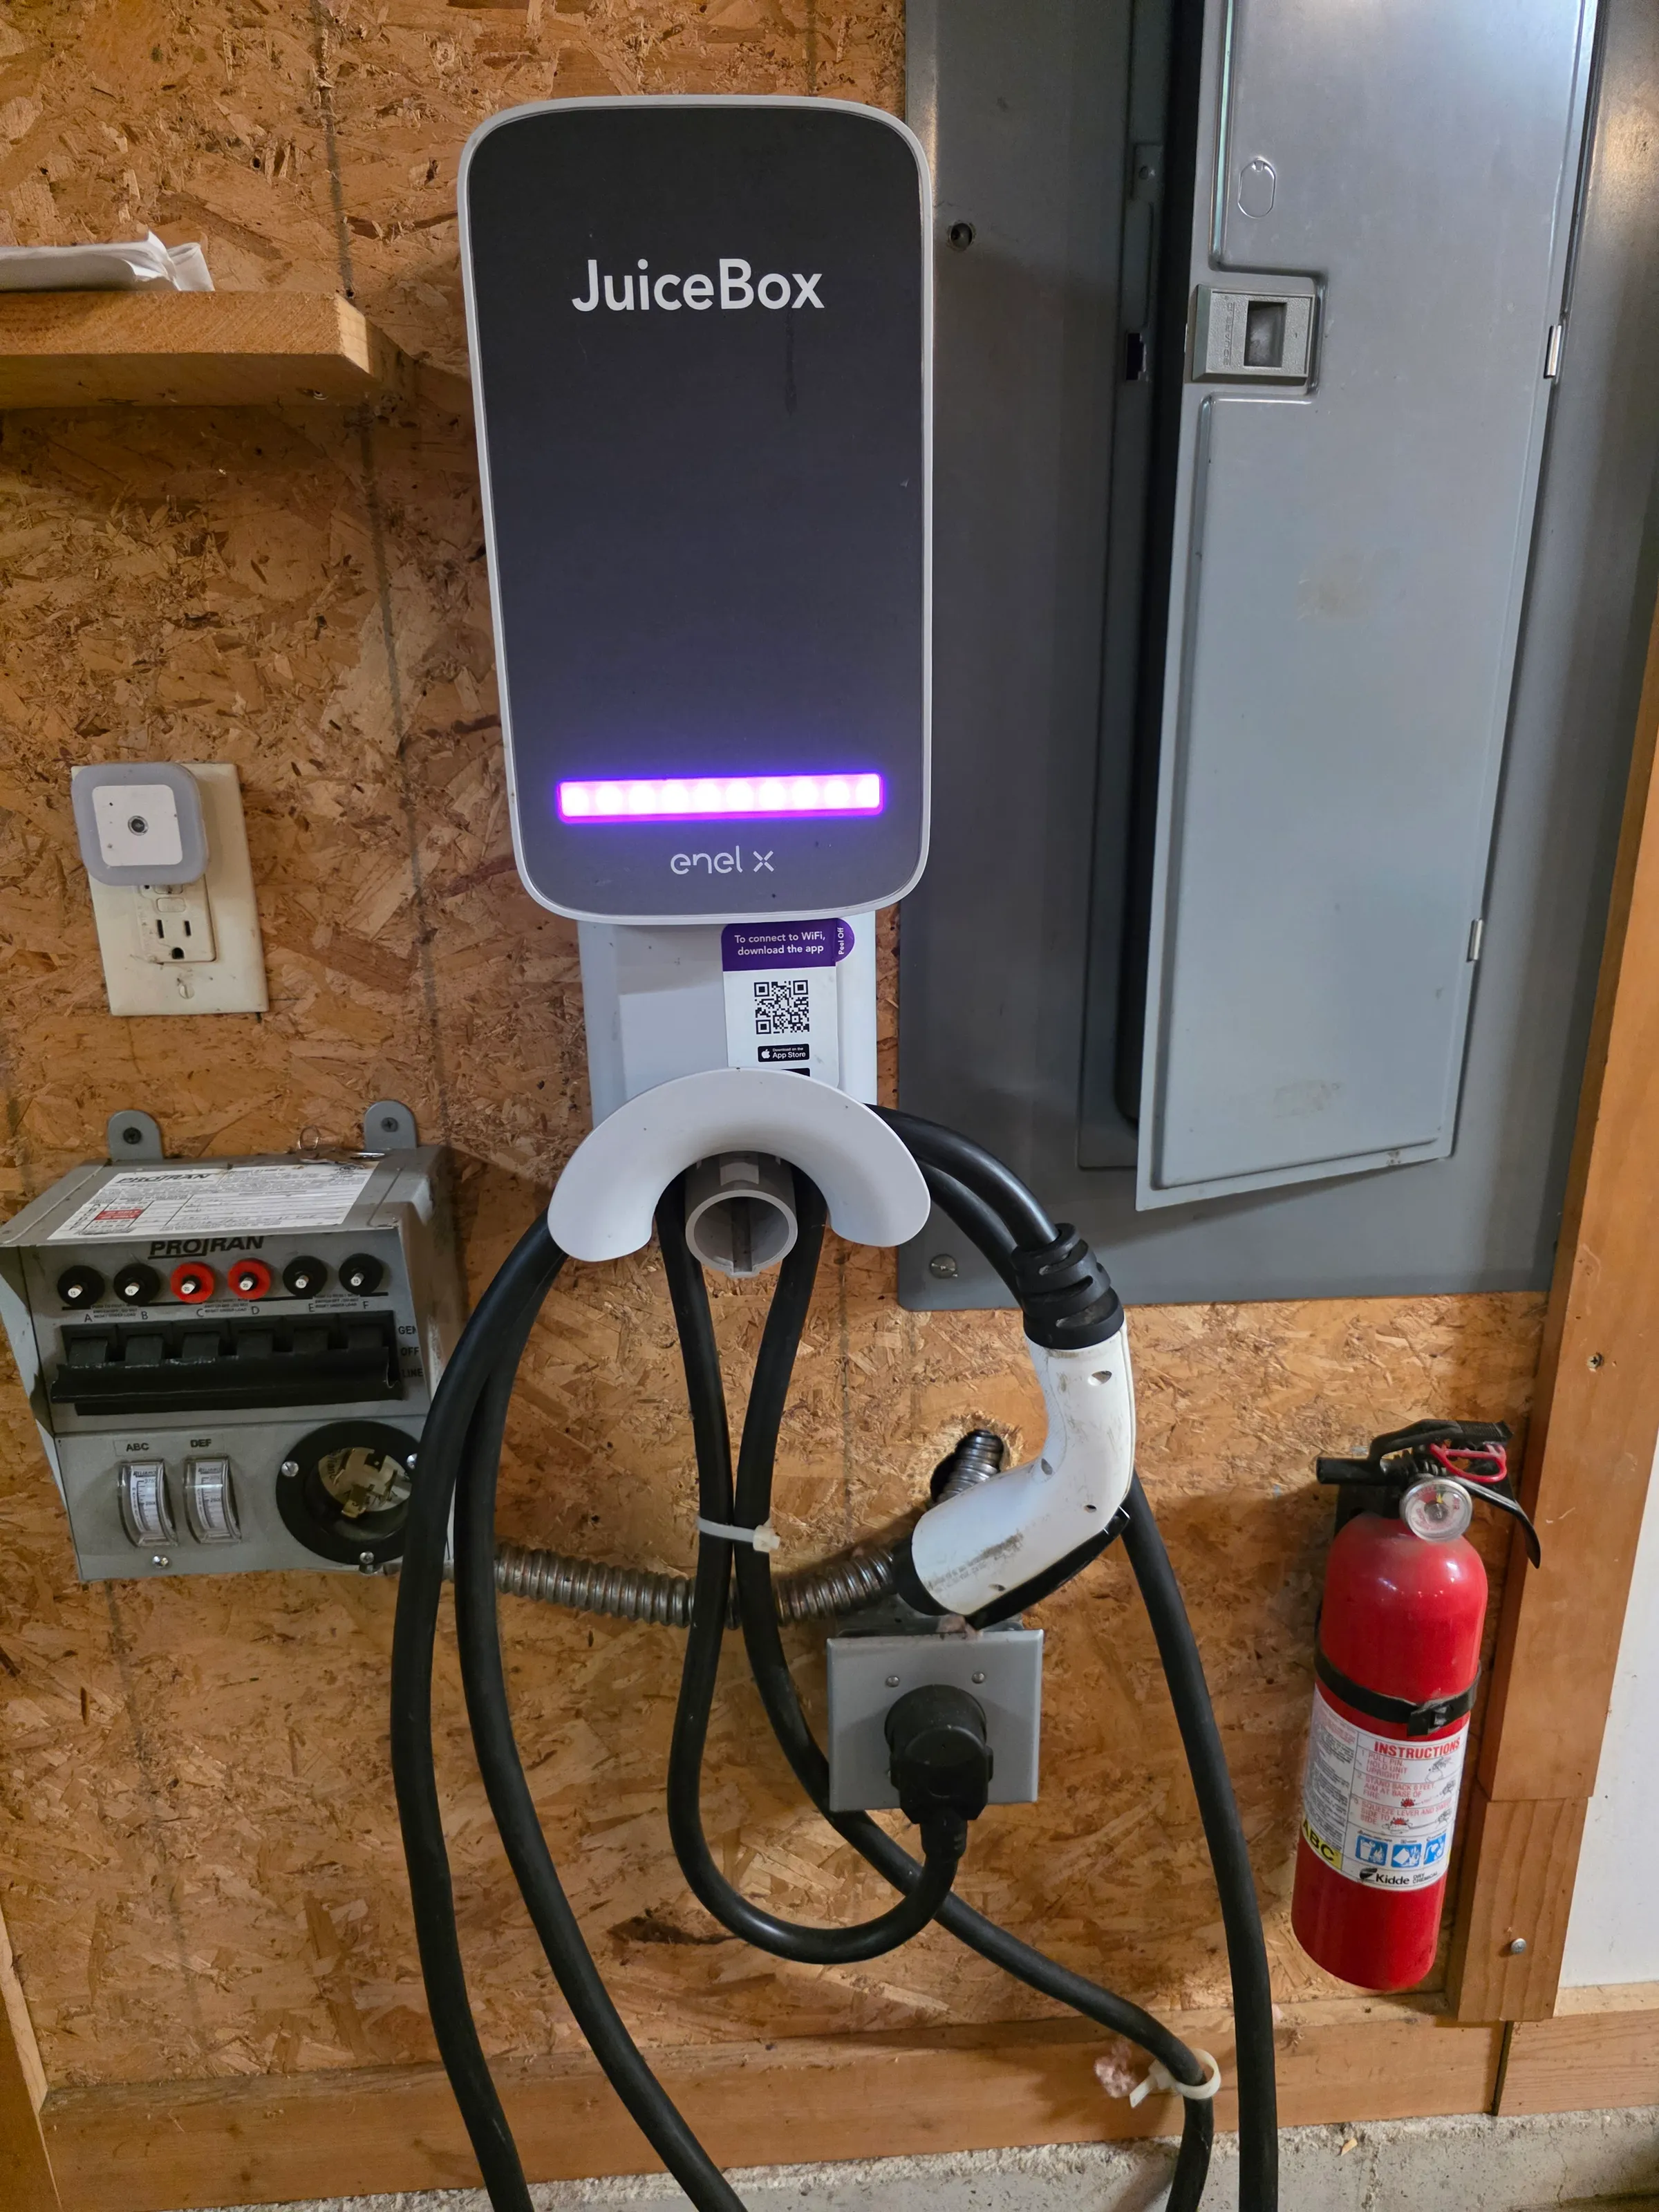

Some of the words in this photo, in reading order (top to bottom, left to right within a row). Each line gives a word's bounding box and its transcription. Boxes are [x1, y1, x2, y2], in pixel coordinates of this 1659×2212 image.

[572, 259, 825, 312] JuiceBox
[671, 845, 743, 875] enel
[734, 935, 746, 944] To
[749, 934, 786, 943] connect
[801, 931, 825, 941] WiFi,
[738, 945, 784, 955] download
[787, 944, 803, 953] the
[805, 945, 824, 954] app
[84, 1313, 93, 1322] A
[141, 1311, 149, 1320] B
[196, 1309, 205, 1317] C
[252, 1306, 259, 1314] D
[308, 1303, 315, 1313] E
[363, 1301, 369, 1309] F
[401, 1347, 420, 1356] OFF
[402, 1369, 423, 1378] LINE
[126, 1443, 149, 1452] ABC
[190, 1439, 212, 1447] DEF
[1374, 1737, 1461, 1759] INSTRUCTIONS
[1369, 1752, 1386, 1763] PULL
[1367, 1759, 1387, 1770] HOLD
[1389, 1765, 1407, 1774] UNIT
[1364, 1783, 1378, 1792] AIM
[1392, 1788, 1410, 1797] BASE
[1361, 1800, 1394, 1815] SQUEEZE
[1361, 1807, 1378, 1819] SIDE
[1303, 1819, 1334, 1861] ABC
[1376, 1873, 1409, 1885] Kidde
